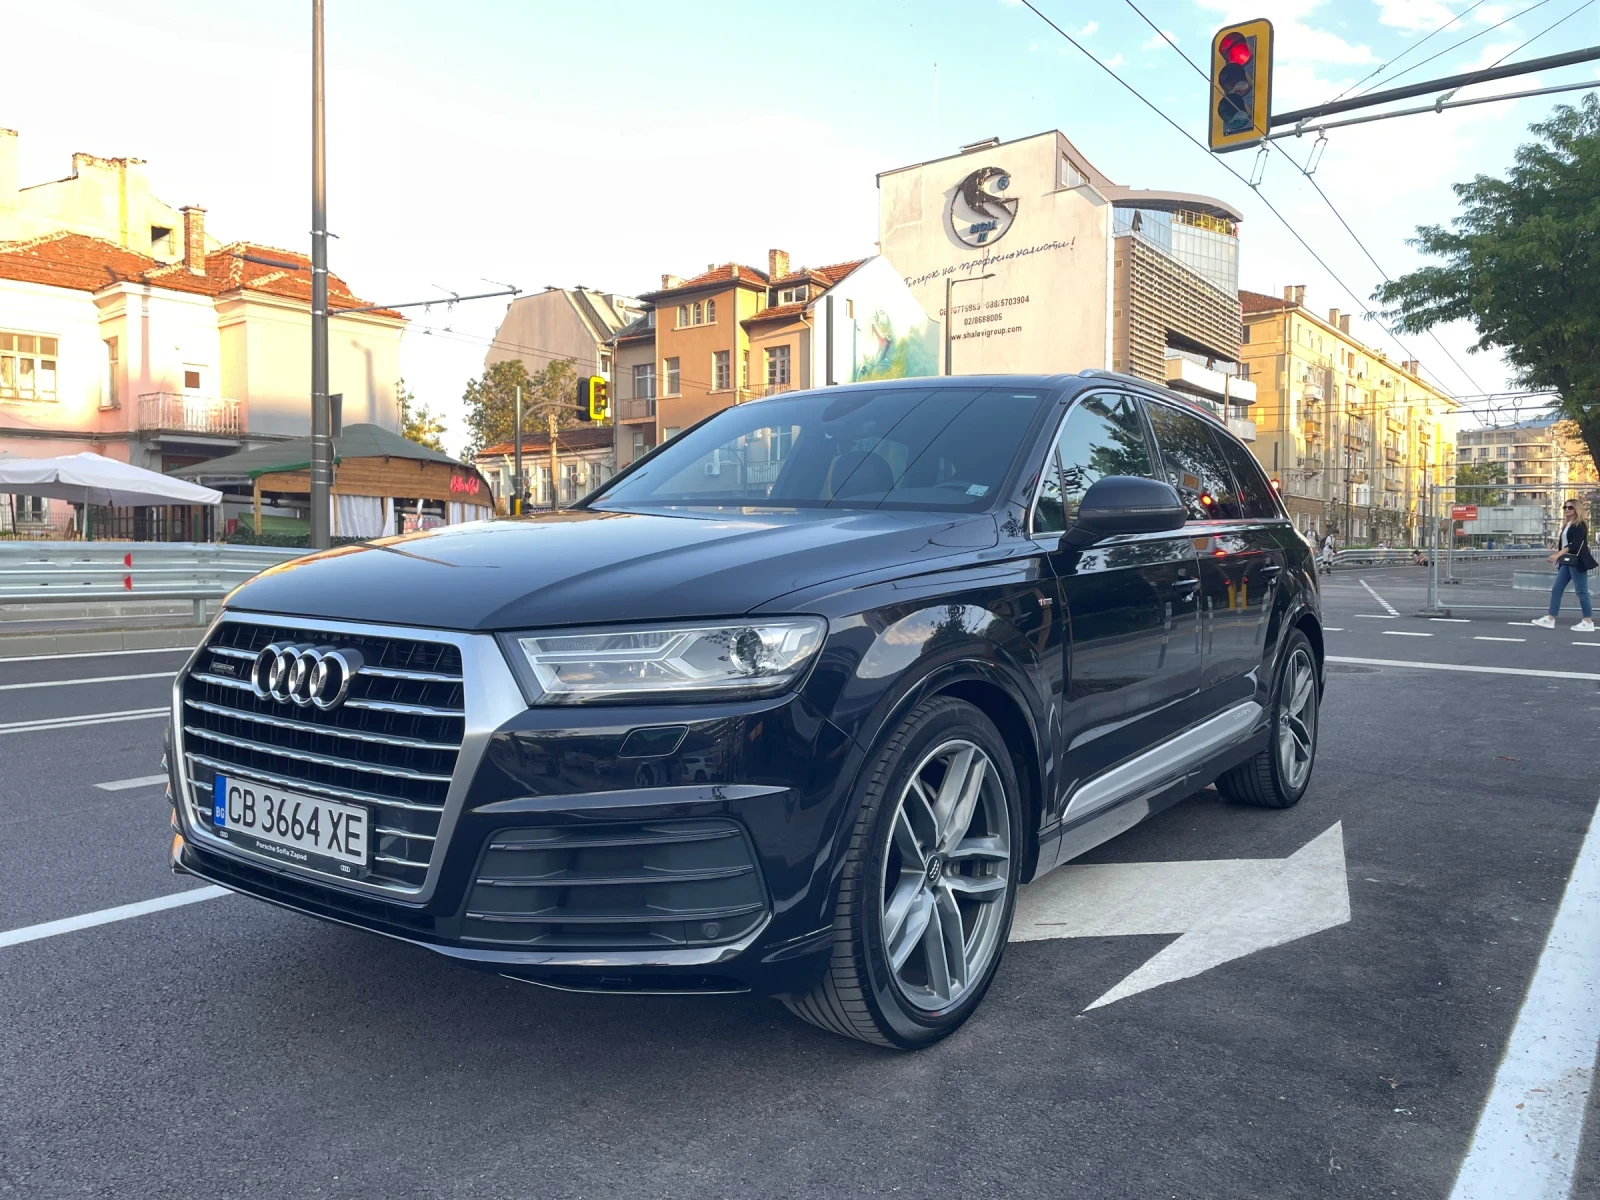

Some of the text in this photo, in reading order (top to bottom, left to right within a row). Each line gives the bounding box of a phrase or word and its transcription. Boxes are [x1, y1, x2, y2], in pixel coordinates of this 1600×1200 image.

[942, 266, 957, 277] на
[215, 806, 225, 819] BG
[228, 786, 362, 858] CB 3664 XE
[256, 840, 308, 861] Porsche Sofia Zapad
